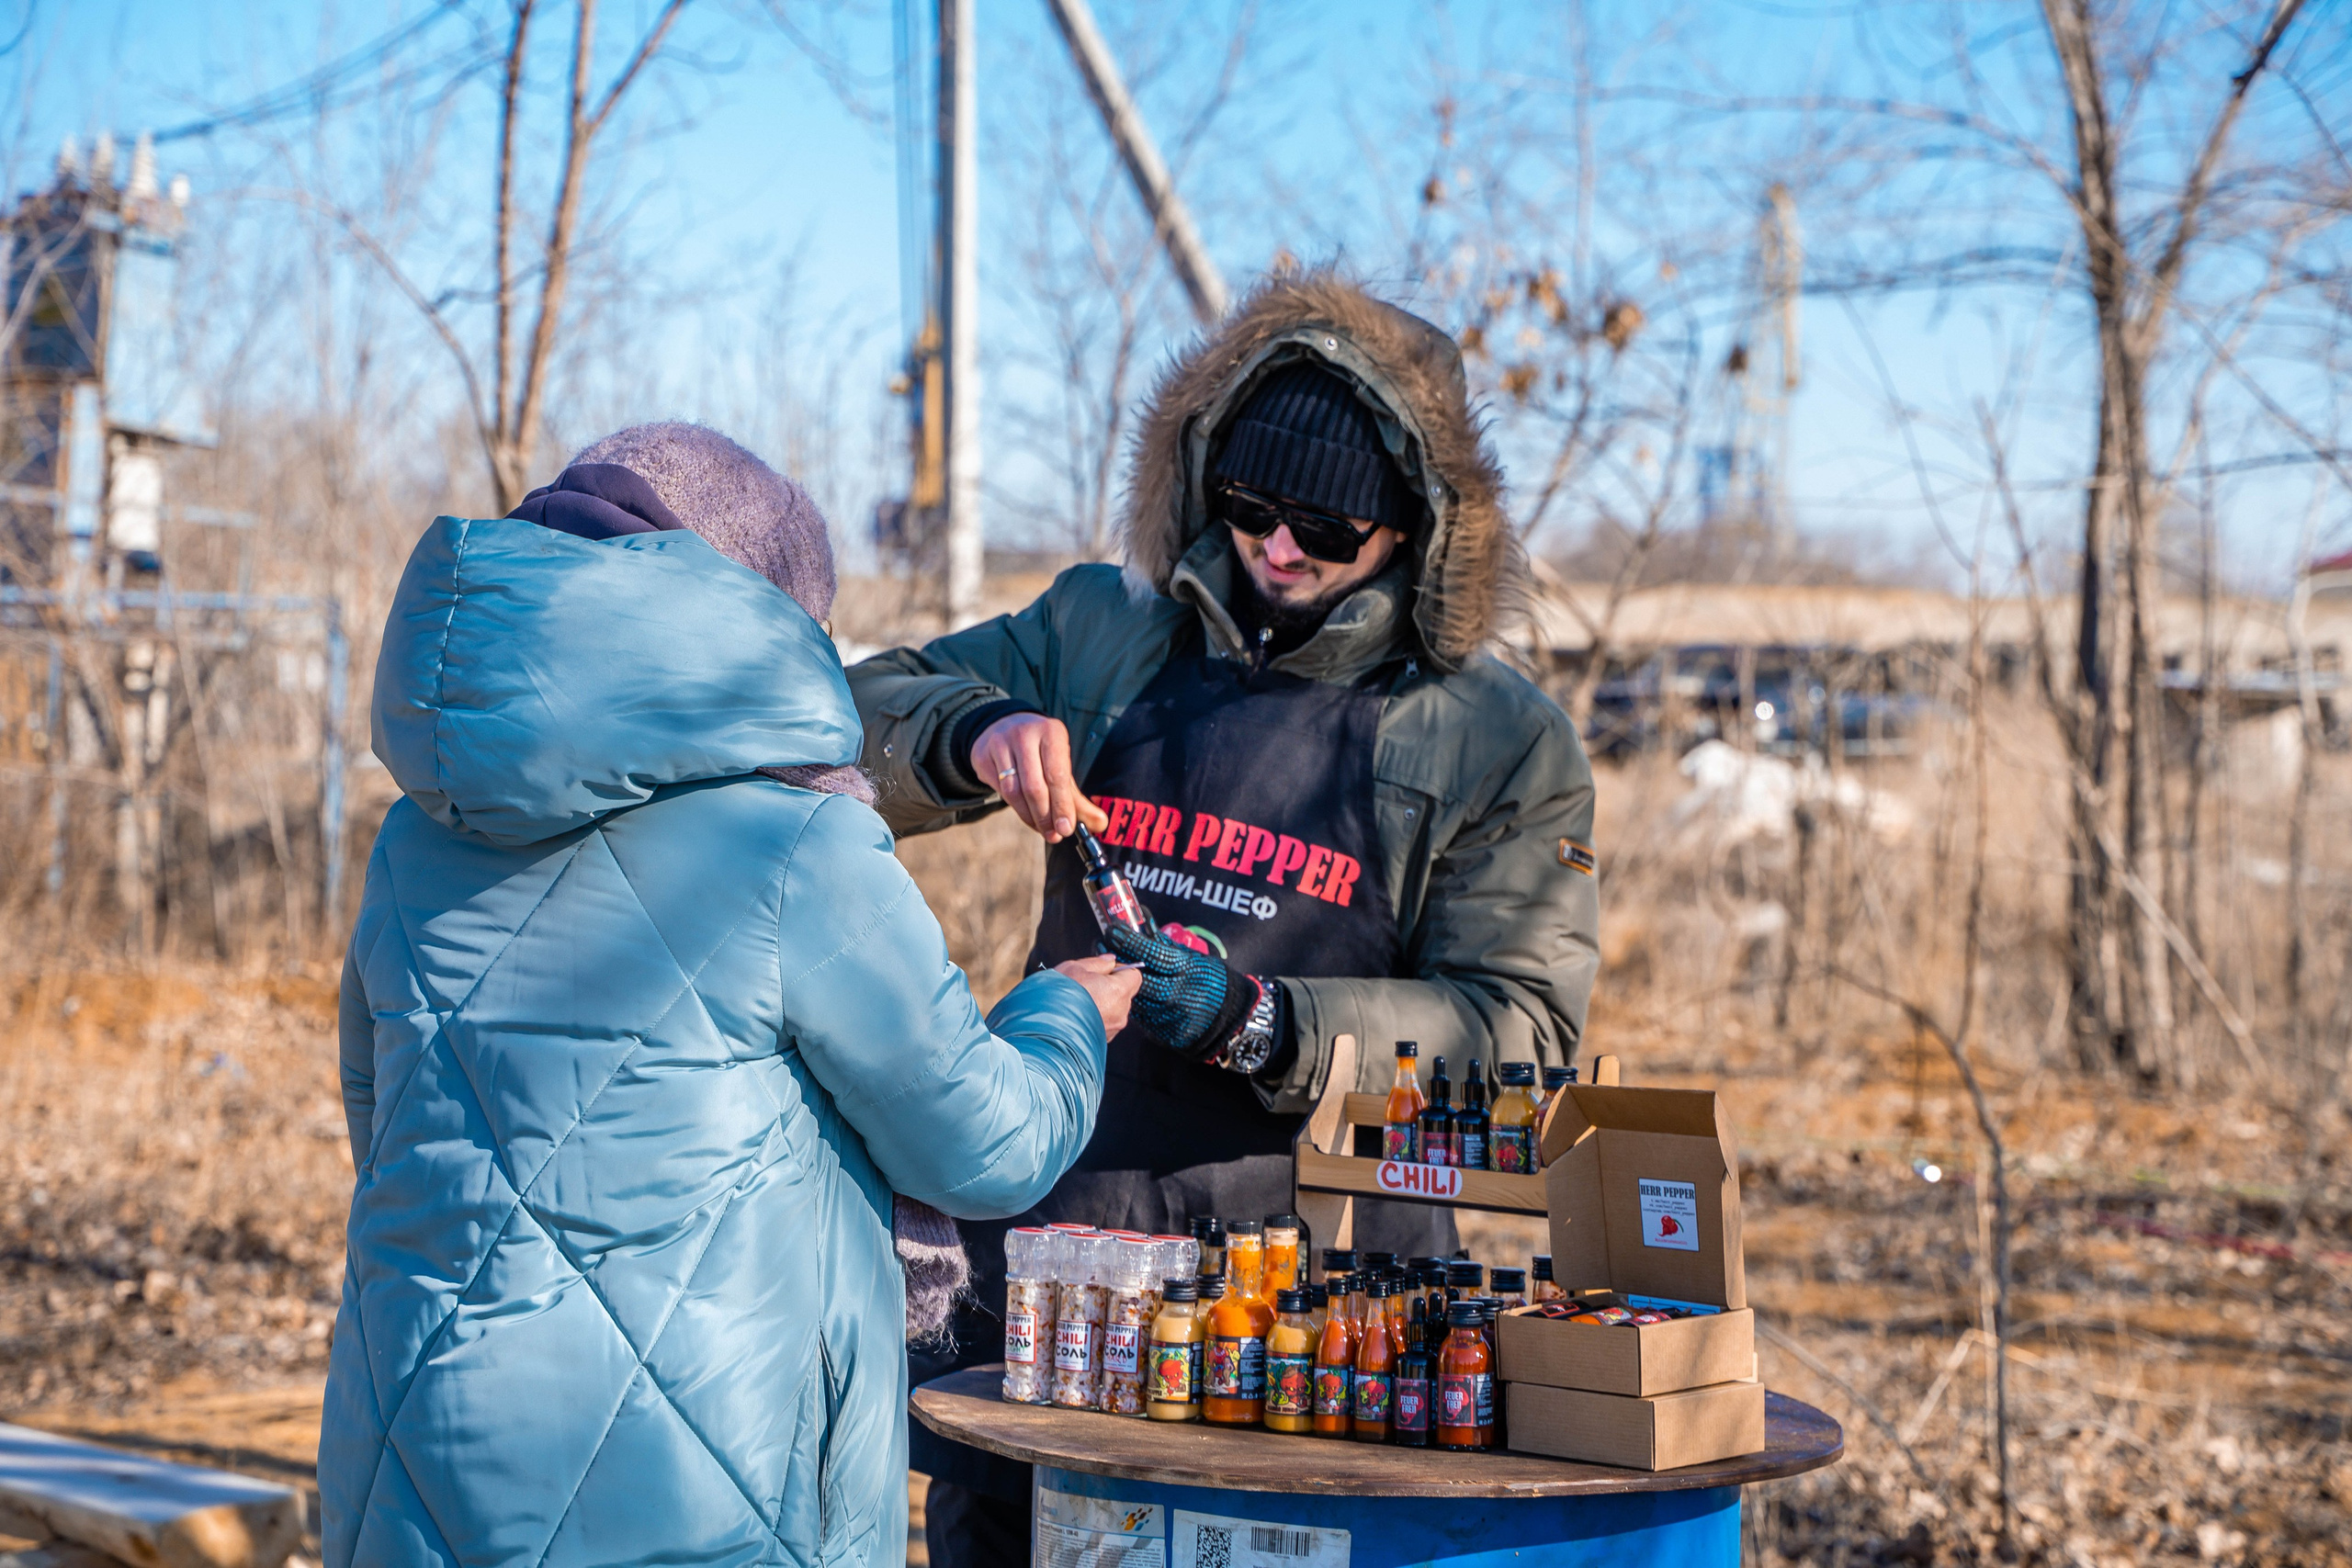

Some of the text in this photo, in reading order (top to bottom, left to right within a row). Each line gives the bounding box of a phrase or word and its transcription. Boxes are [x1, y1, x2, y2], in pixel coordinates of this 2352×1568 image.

[1183, 812, 1361, 908] PEPPER
[1124, 862, 1278, 920] ЧИЛИ-ШЕФ
[1381, 1162, 1455, 1195] CHILI
[1640, 1185, 1695, 1200] HERR PEPPER
[1067, 1324, 1088, 1332] PEPPER
[1057, 1331, 1088, 1345] CHILI
[1105, 1333, 1136, 1347] CHILI
[1400, 1395, 1419, 1405] FEUER
[1444, 1391, 1464, 1401] FEUER
